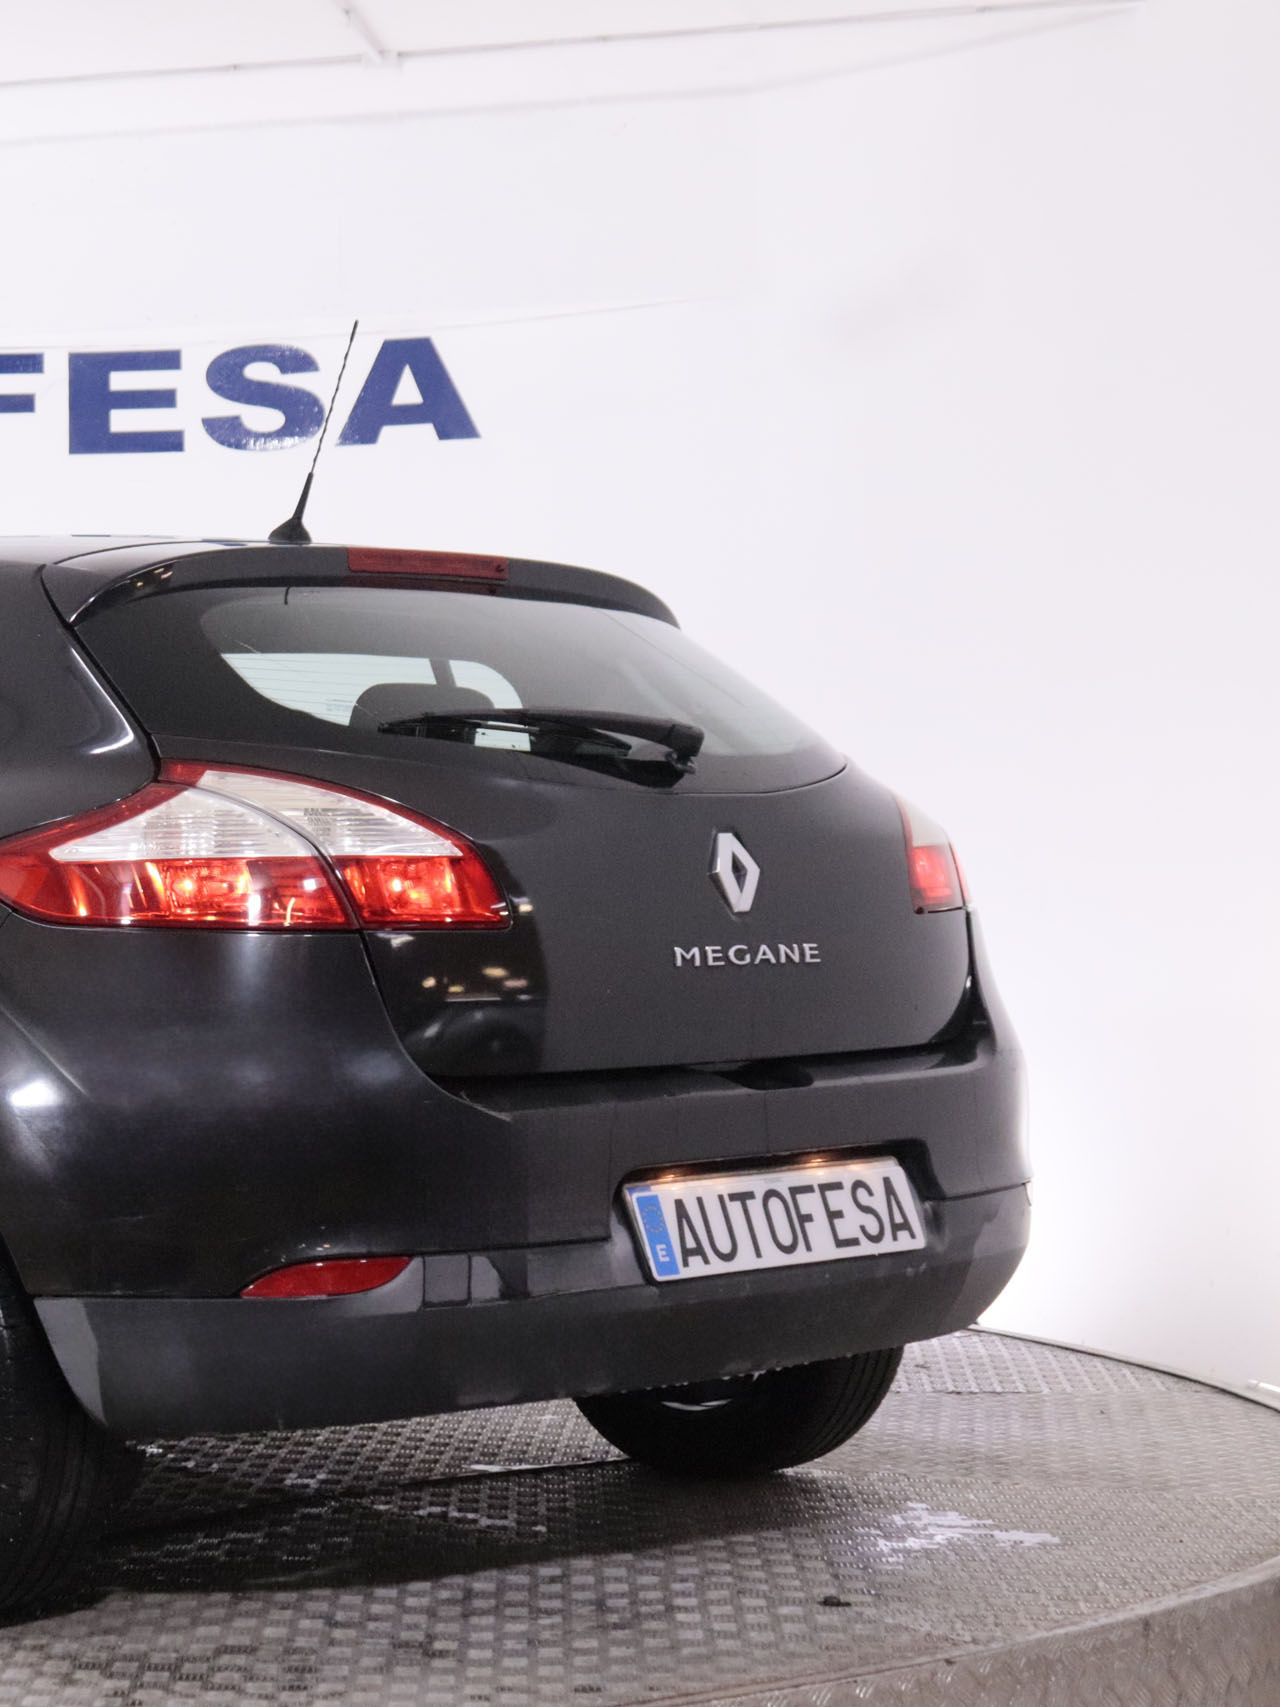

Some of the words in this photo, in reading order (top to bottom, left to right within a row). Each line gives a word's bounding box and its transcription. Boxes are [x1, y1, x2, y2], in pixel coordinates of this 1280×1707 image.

[674, 943, 822, 967] MEGANE
[674, 1176, 916, 1268] AUTOFESA
[656, 1244, 670, 1263] E
